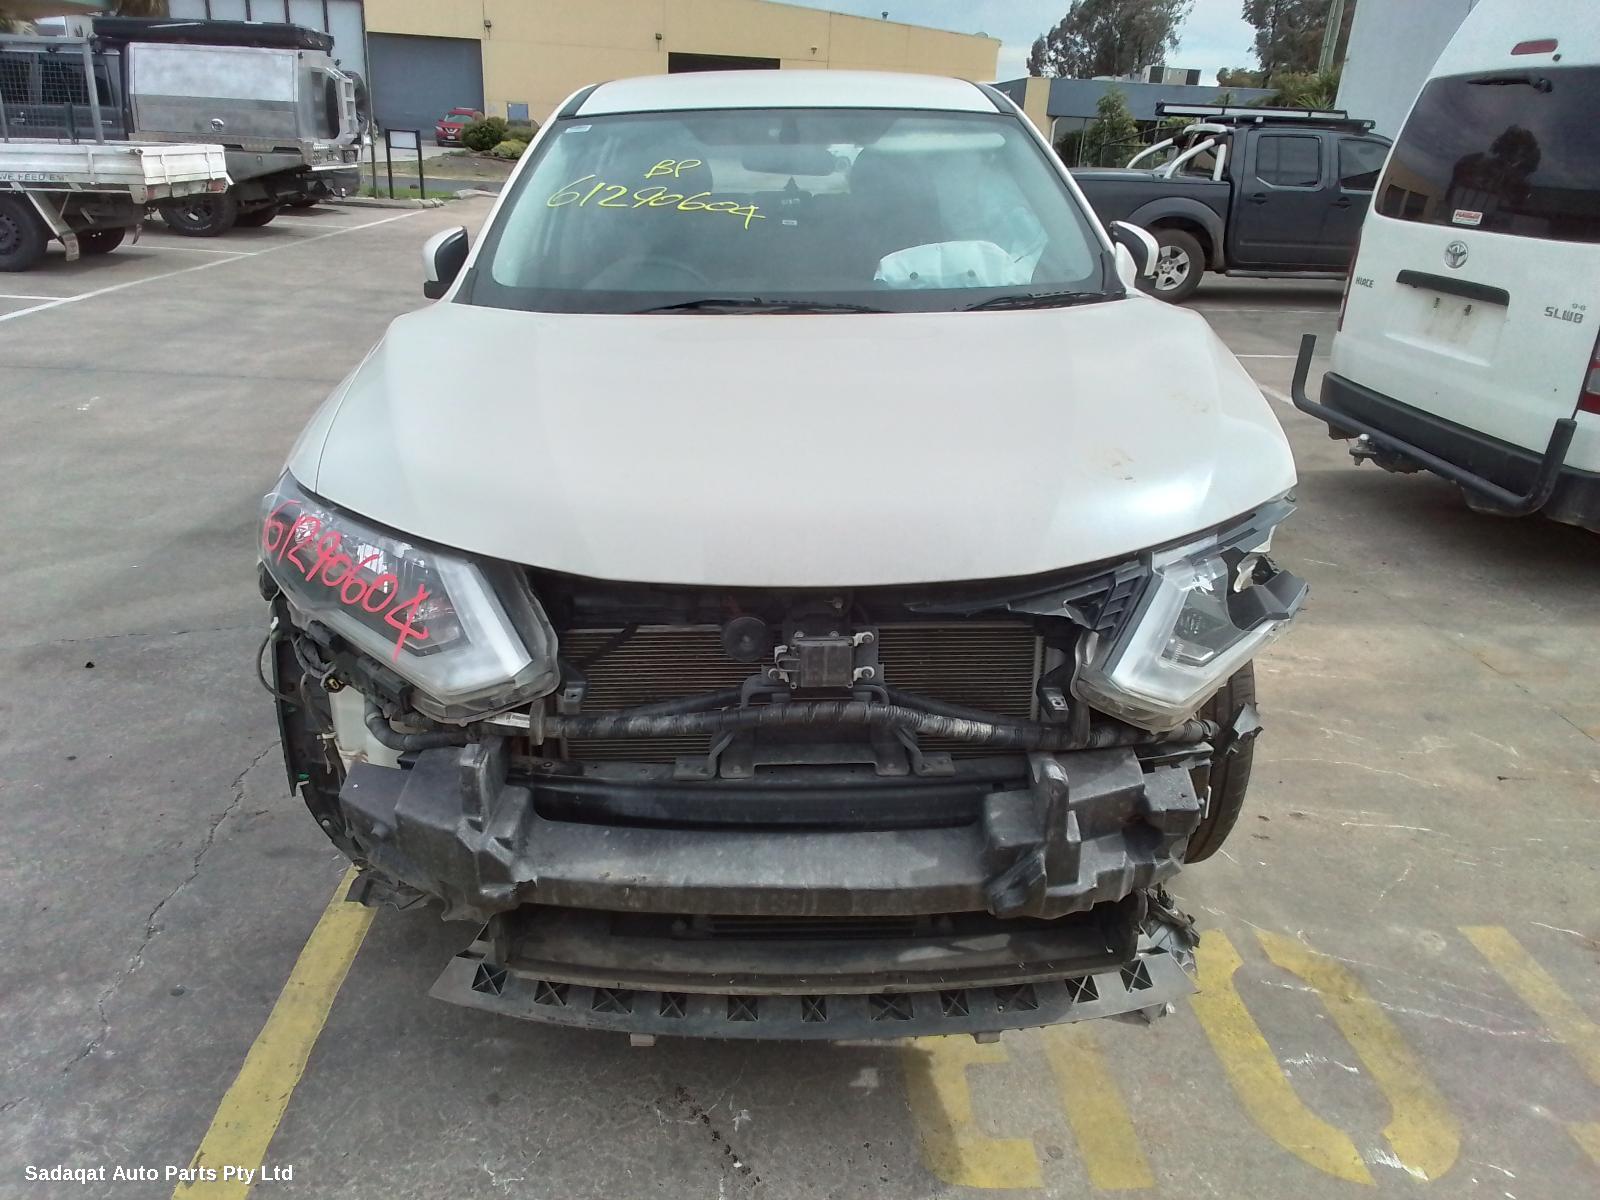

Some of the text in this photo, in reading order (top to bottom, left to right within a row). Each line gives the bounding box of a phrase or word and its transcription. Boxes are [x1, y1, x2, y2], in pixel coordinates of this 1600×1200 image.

[18, 173, 46, 181] FEED
[644, 159, 702, 179] BP
[546, 174, 767, 231] 61290604
[1355, 276, 1375, 289] HIACE
[1544, 306, 1584, 324] SLWB
[262, 499, 433, 664] 61290604
